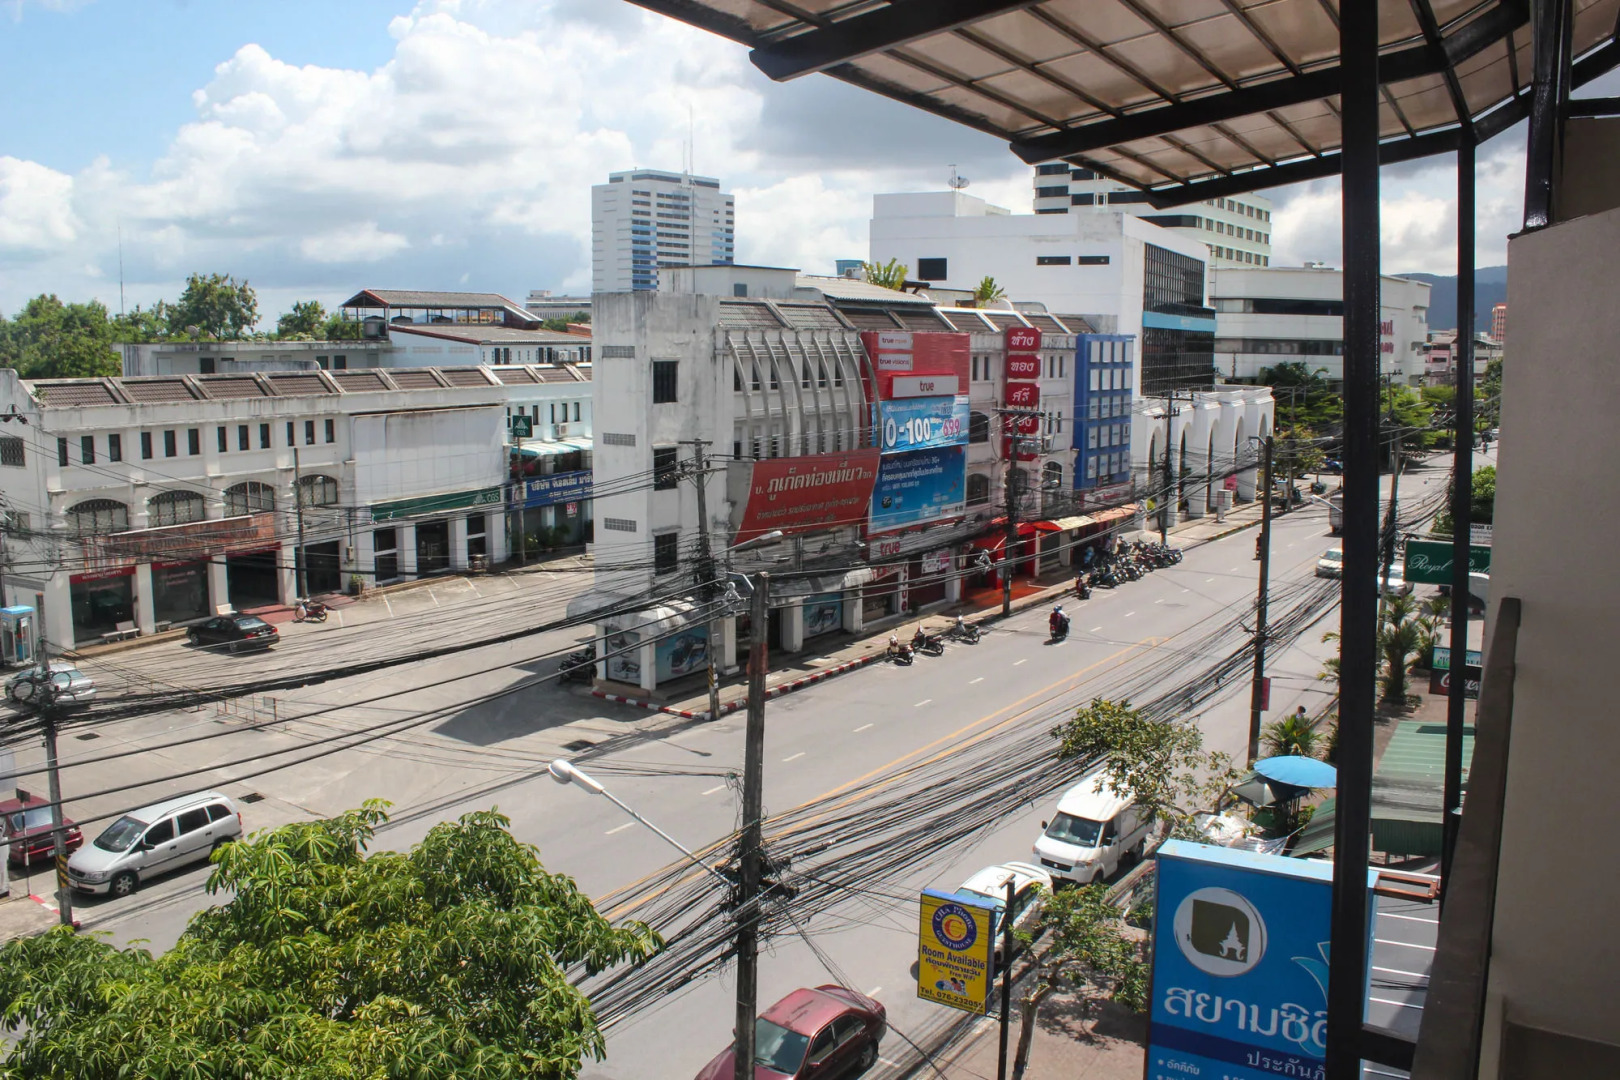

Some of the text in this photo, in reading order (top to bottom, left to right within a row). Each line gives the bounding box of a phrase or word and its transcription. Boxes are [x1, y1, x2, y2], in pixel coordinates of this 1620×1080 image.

[919, 381, 935, 392] true
[942, 419, 960, 437] 699
[767, 458, 863, 500] ภูเก็ตท่องเที่ยว
[486, 493, 499, 502] CGS
[880, 542, 901, 556] true
[1408, 554, 1453, 575] Royal
[922, 945, 986, 970] Room Available
[949, 969, 962, 978] Free
[920, 986, 935, 997] Tel.
